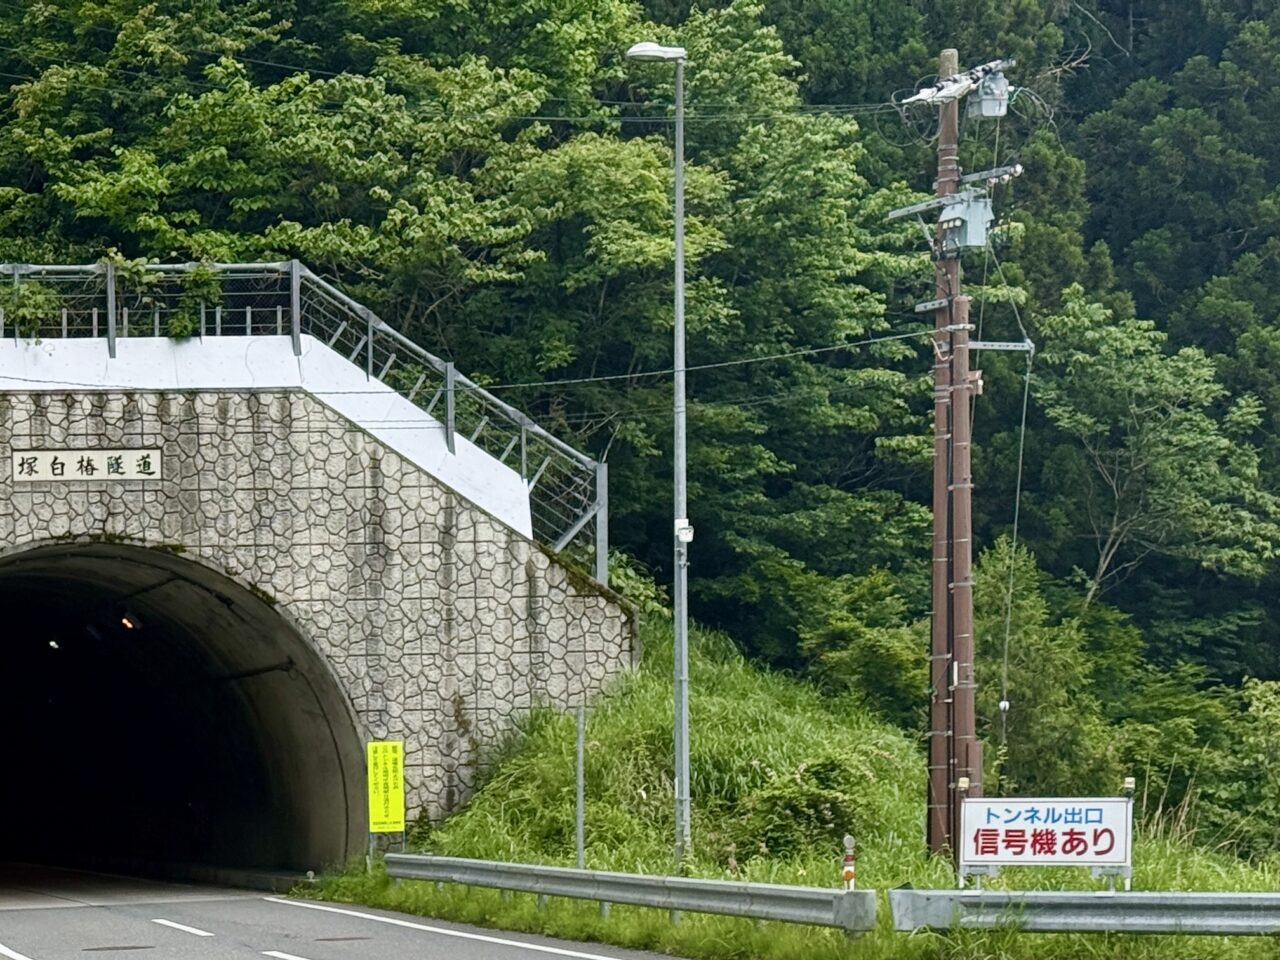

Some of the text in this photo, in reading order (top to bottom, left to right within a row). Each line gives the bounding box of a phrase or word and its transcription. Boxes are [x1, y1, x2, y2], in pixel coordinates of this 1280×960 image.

[17, 453, 157, 477] 塚白椿隧道
[986, 806, 1104, 825] トンネル出口
[973, 828, 1116, 856] 信号機あり
